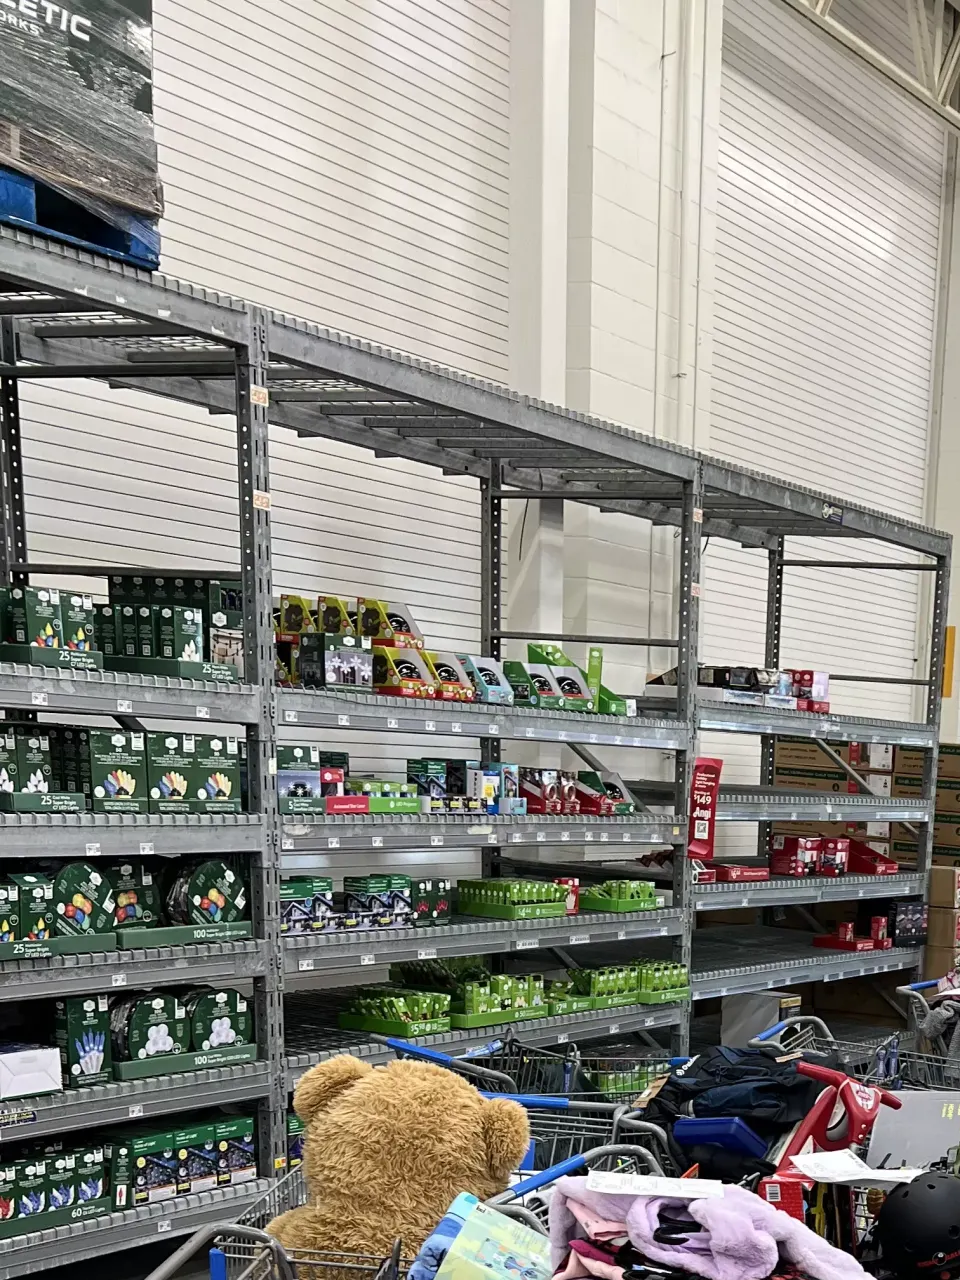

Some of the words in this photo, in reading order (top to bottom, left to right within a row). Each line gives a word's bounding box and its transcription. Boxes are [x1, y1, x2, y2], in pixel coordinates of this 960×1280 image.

[59, 651, 70, 661] 25
[203, 664, 211, 674] 25
[41, 796, 52, 805] 25
[694, 794, 712, 805] $149
[693, 806, 711, 820] Angi
[193, 929, 206, 938] 100
[13, 944, 25, 954] 25
[195, 1055, 207, 1065] 100
[71, 1207, 82, 1218] 60
